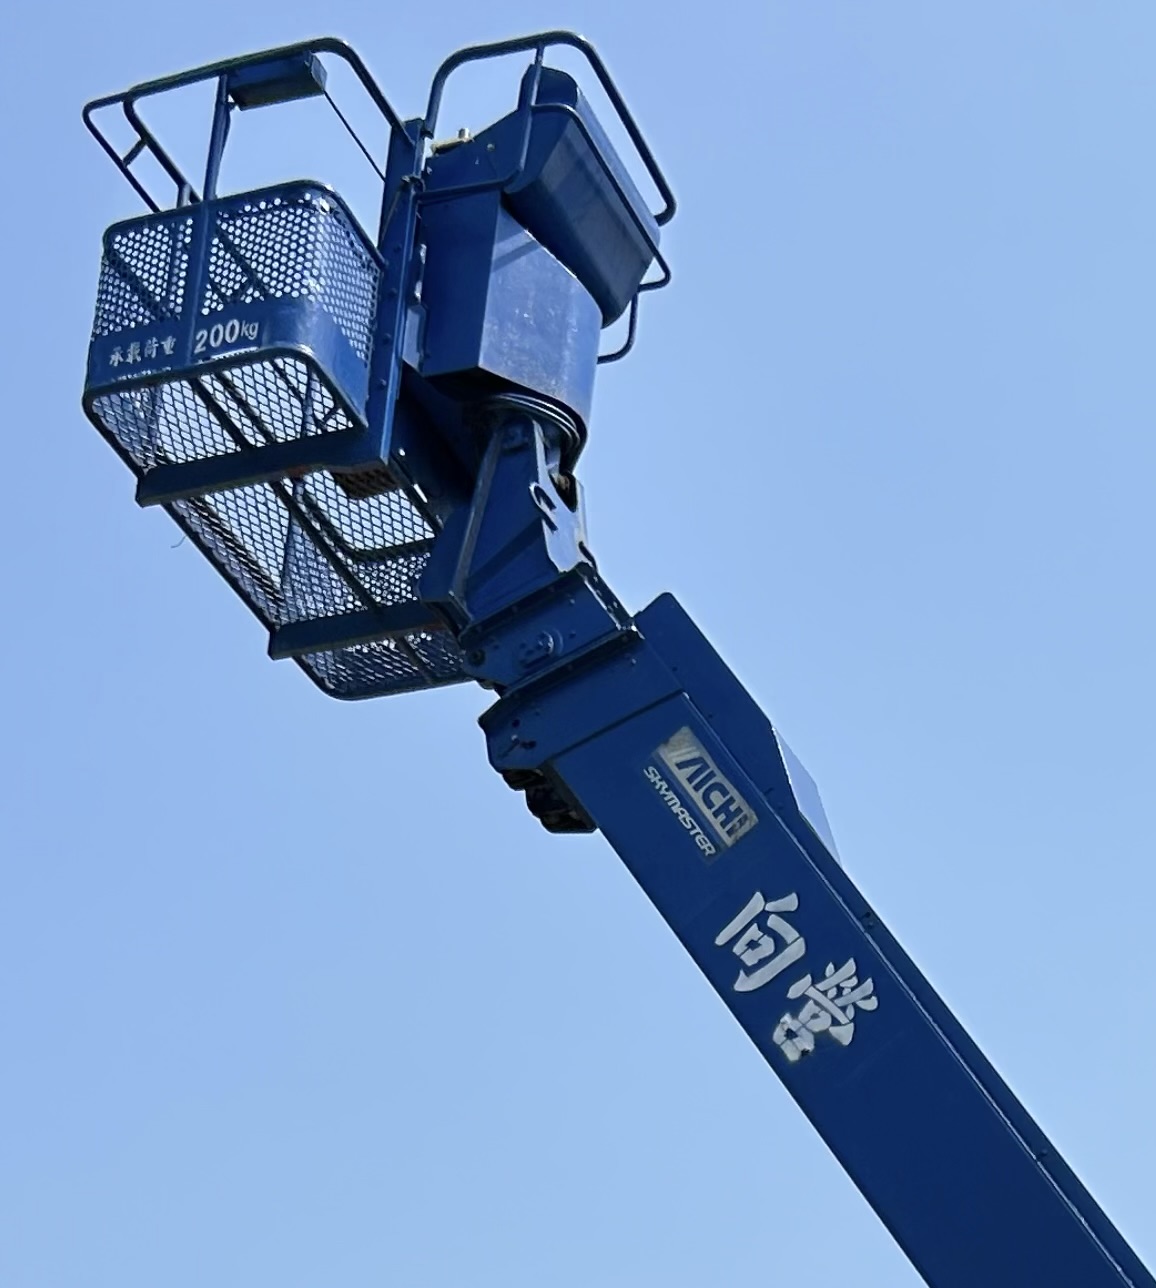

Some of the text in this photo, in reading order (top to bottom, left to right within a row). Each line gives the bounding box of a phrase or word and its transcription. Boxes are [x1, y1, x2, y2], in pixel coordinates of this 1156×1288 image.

[194, 319, 259, 354] 200kg
[643, 766, 716, 856] SKYMASTER
[675, 756, 749, 838] AICHI
